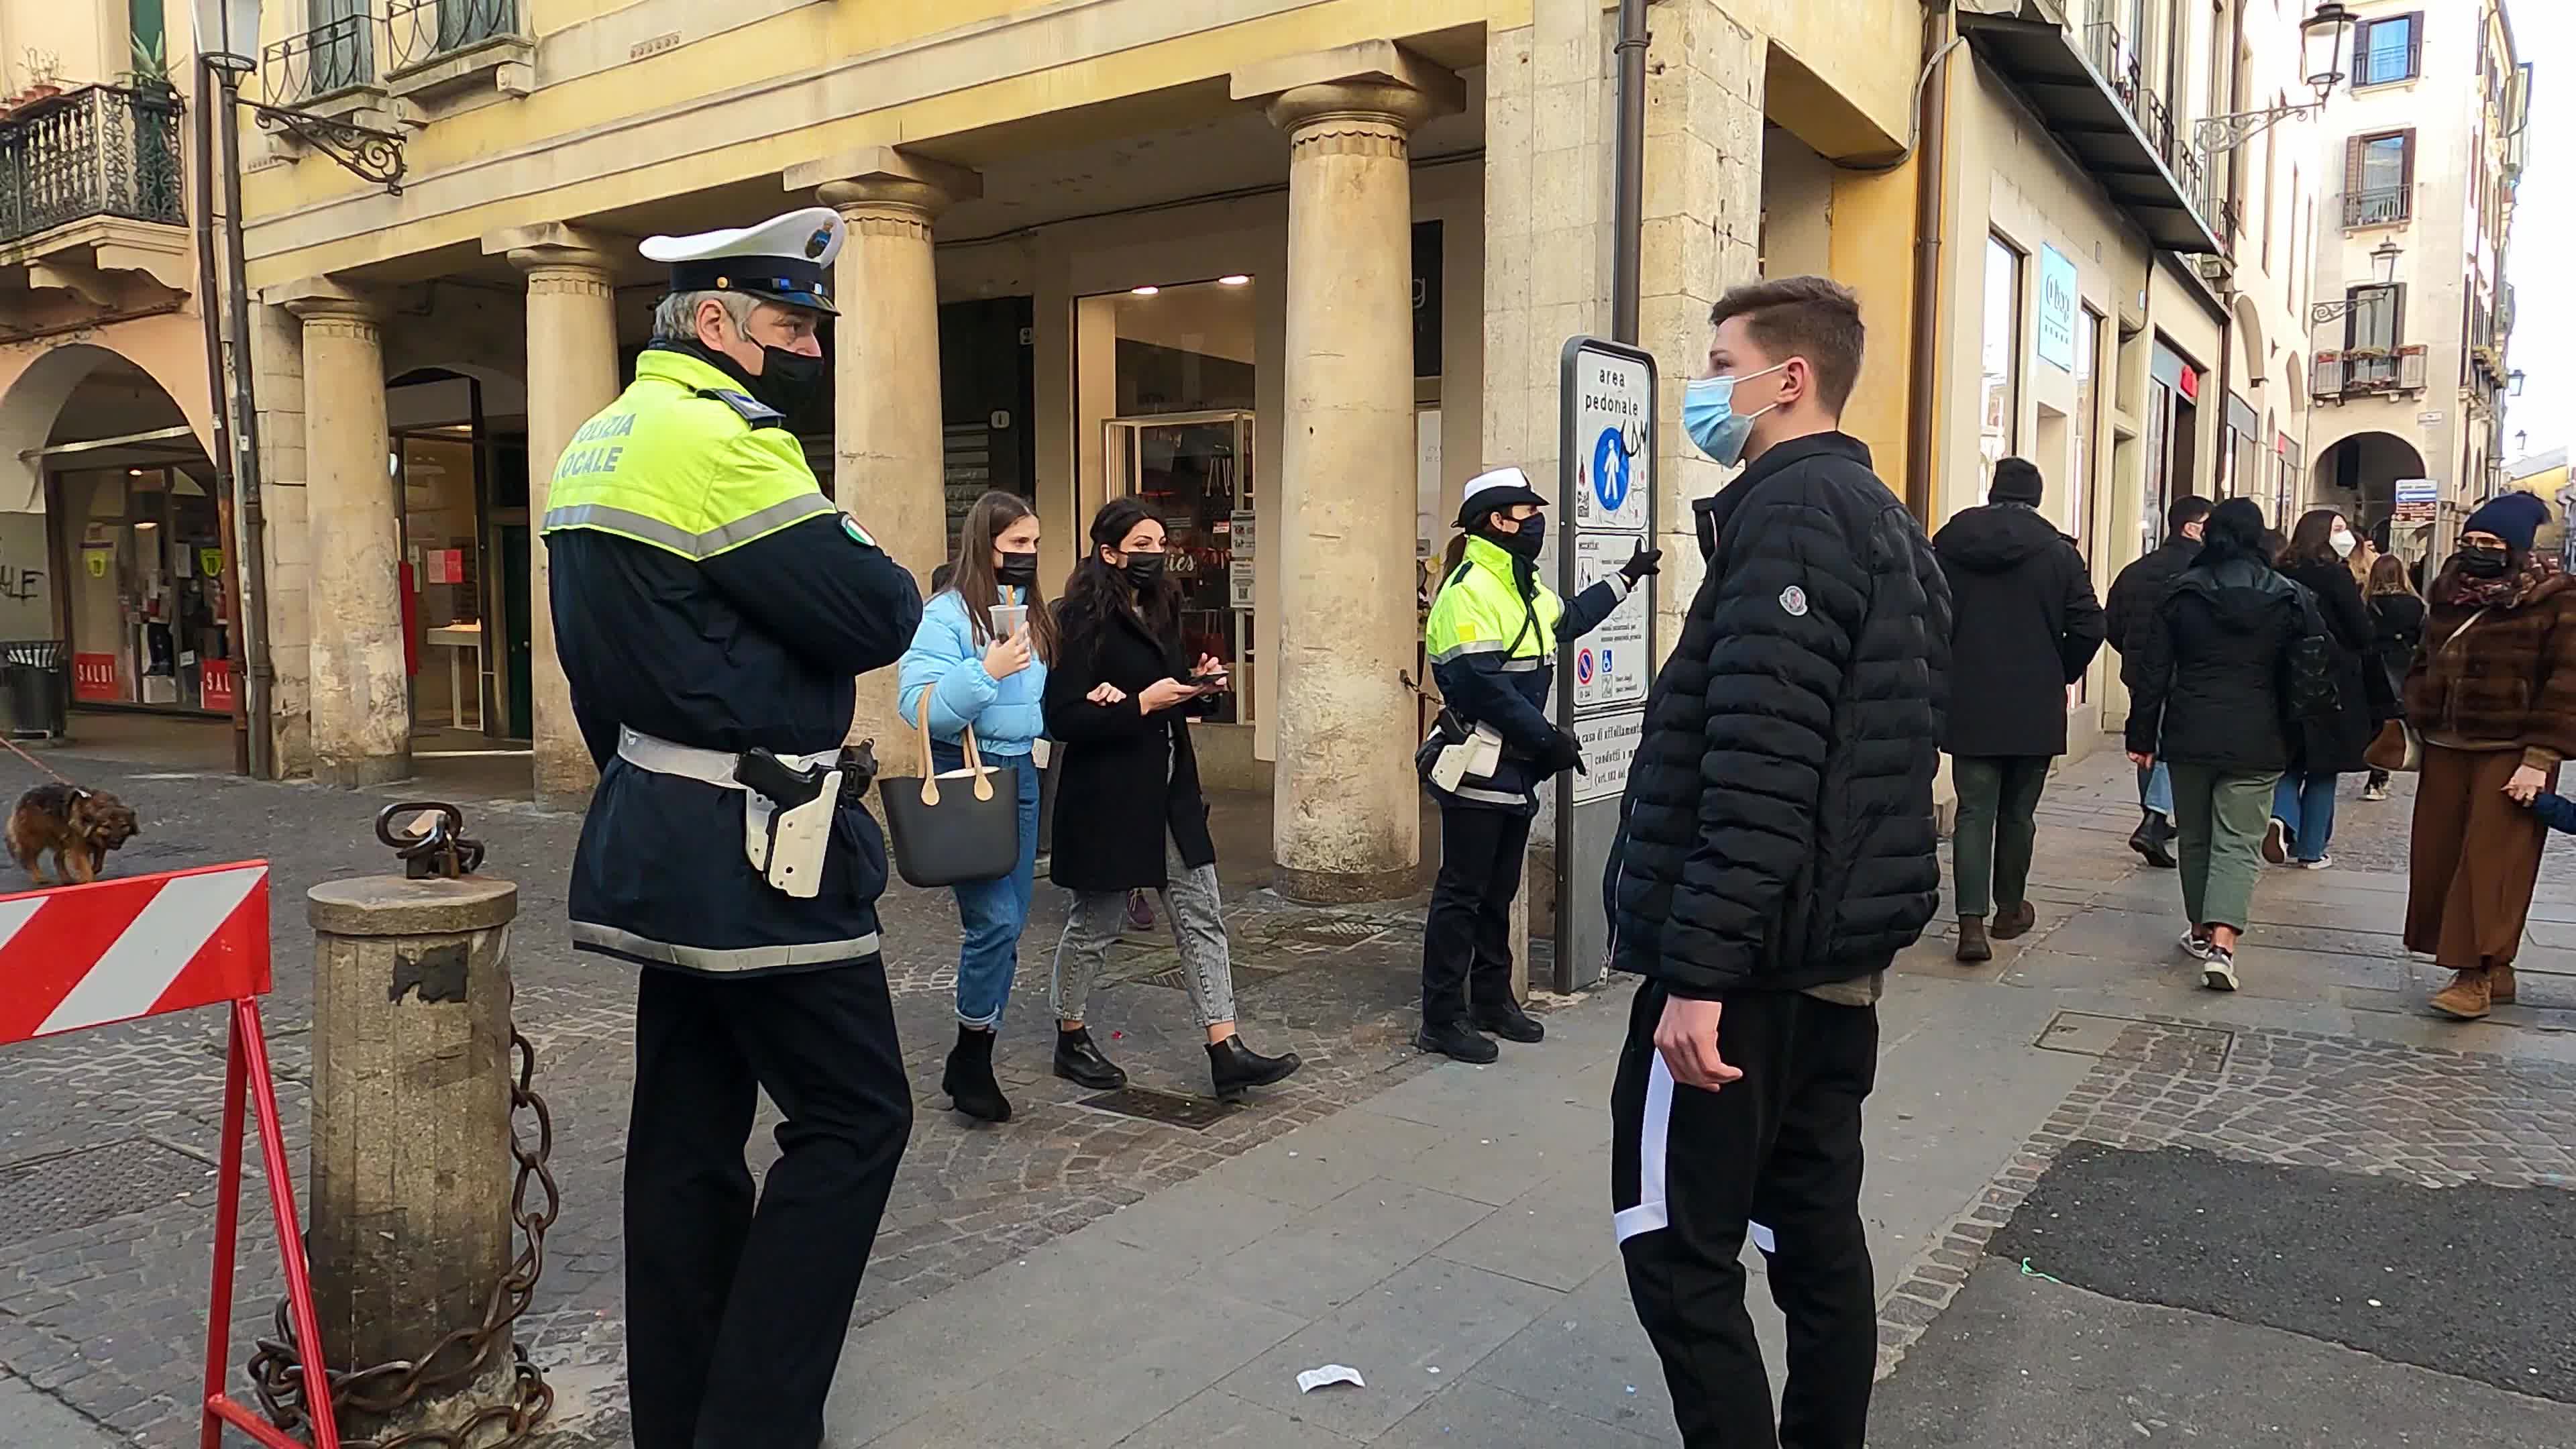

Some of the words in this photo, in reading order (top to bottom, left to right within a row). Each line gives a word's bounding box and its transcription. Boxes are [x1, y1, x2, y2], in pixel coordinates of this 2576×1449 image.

[1599, 369, 1625, 387] area
[1585, 392, 1638, 416] pedonale
[574, 413, 636, 443] OLIZIA
[206, 672, 231, 692] SAL
[1582, 733, 1595, 743] caso
